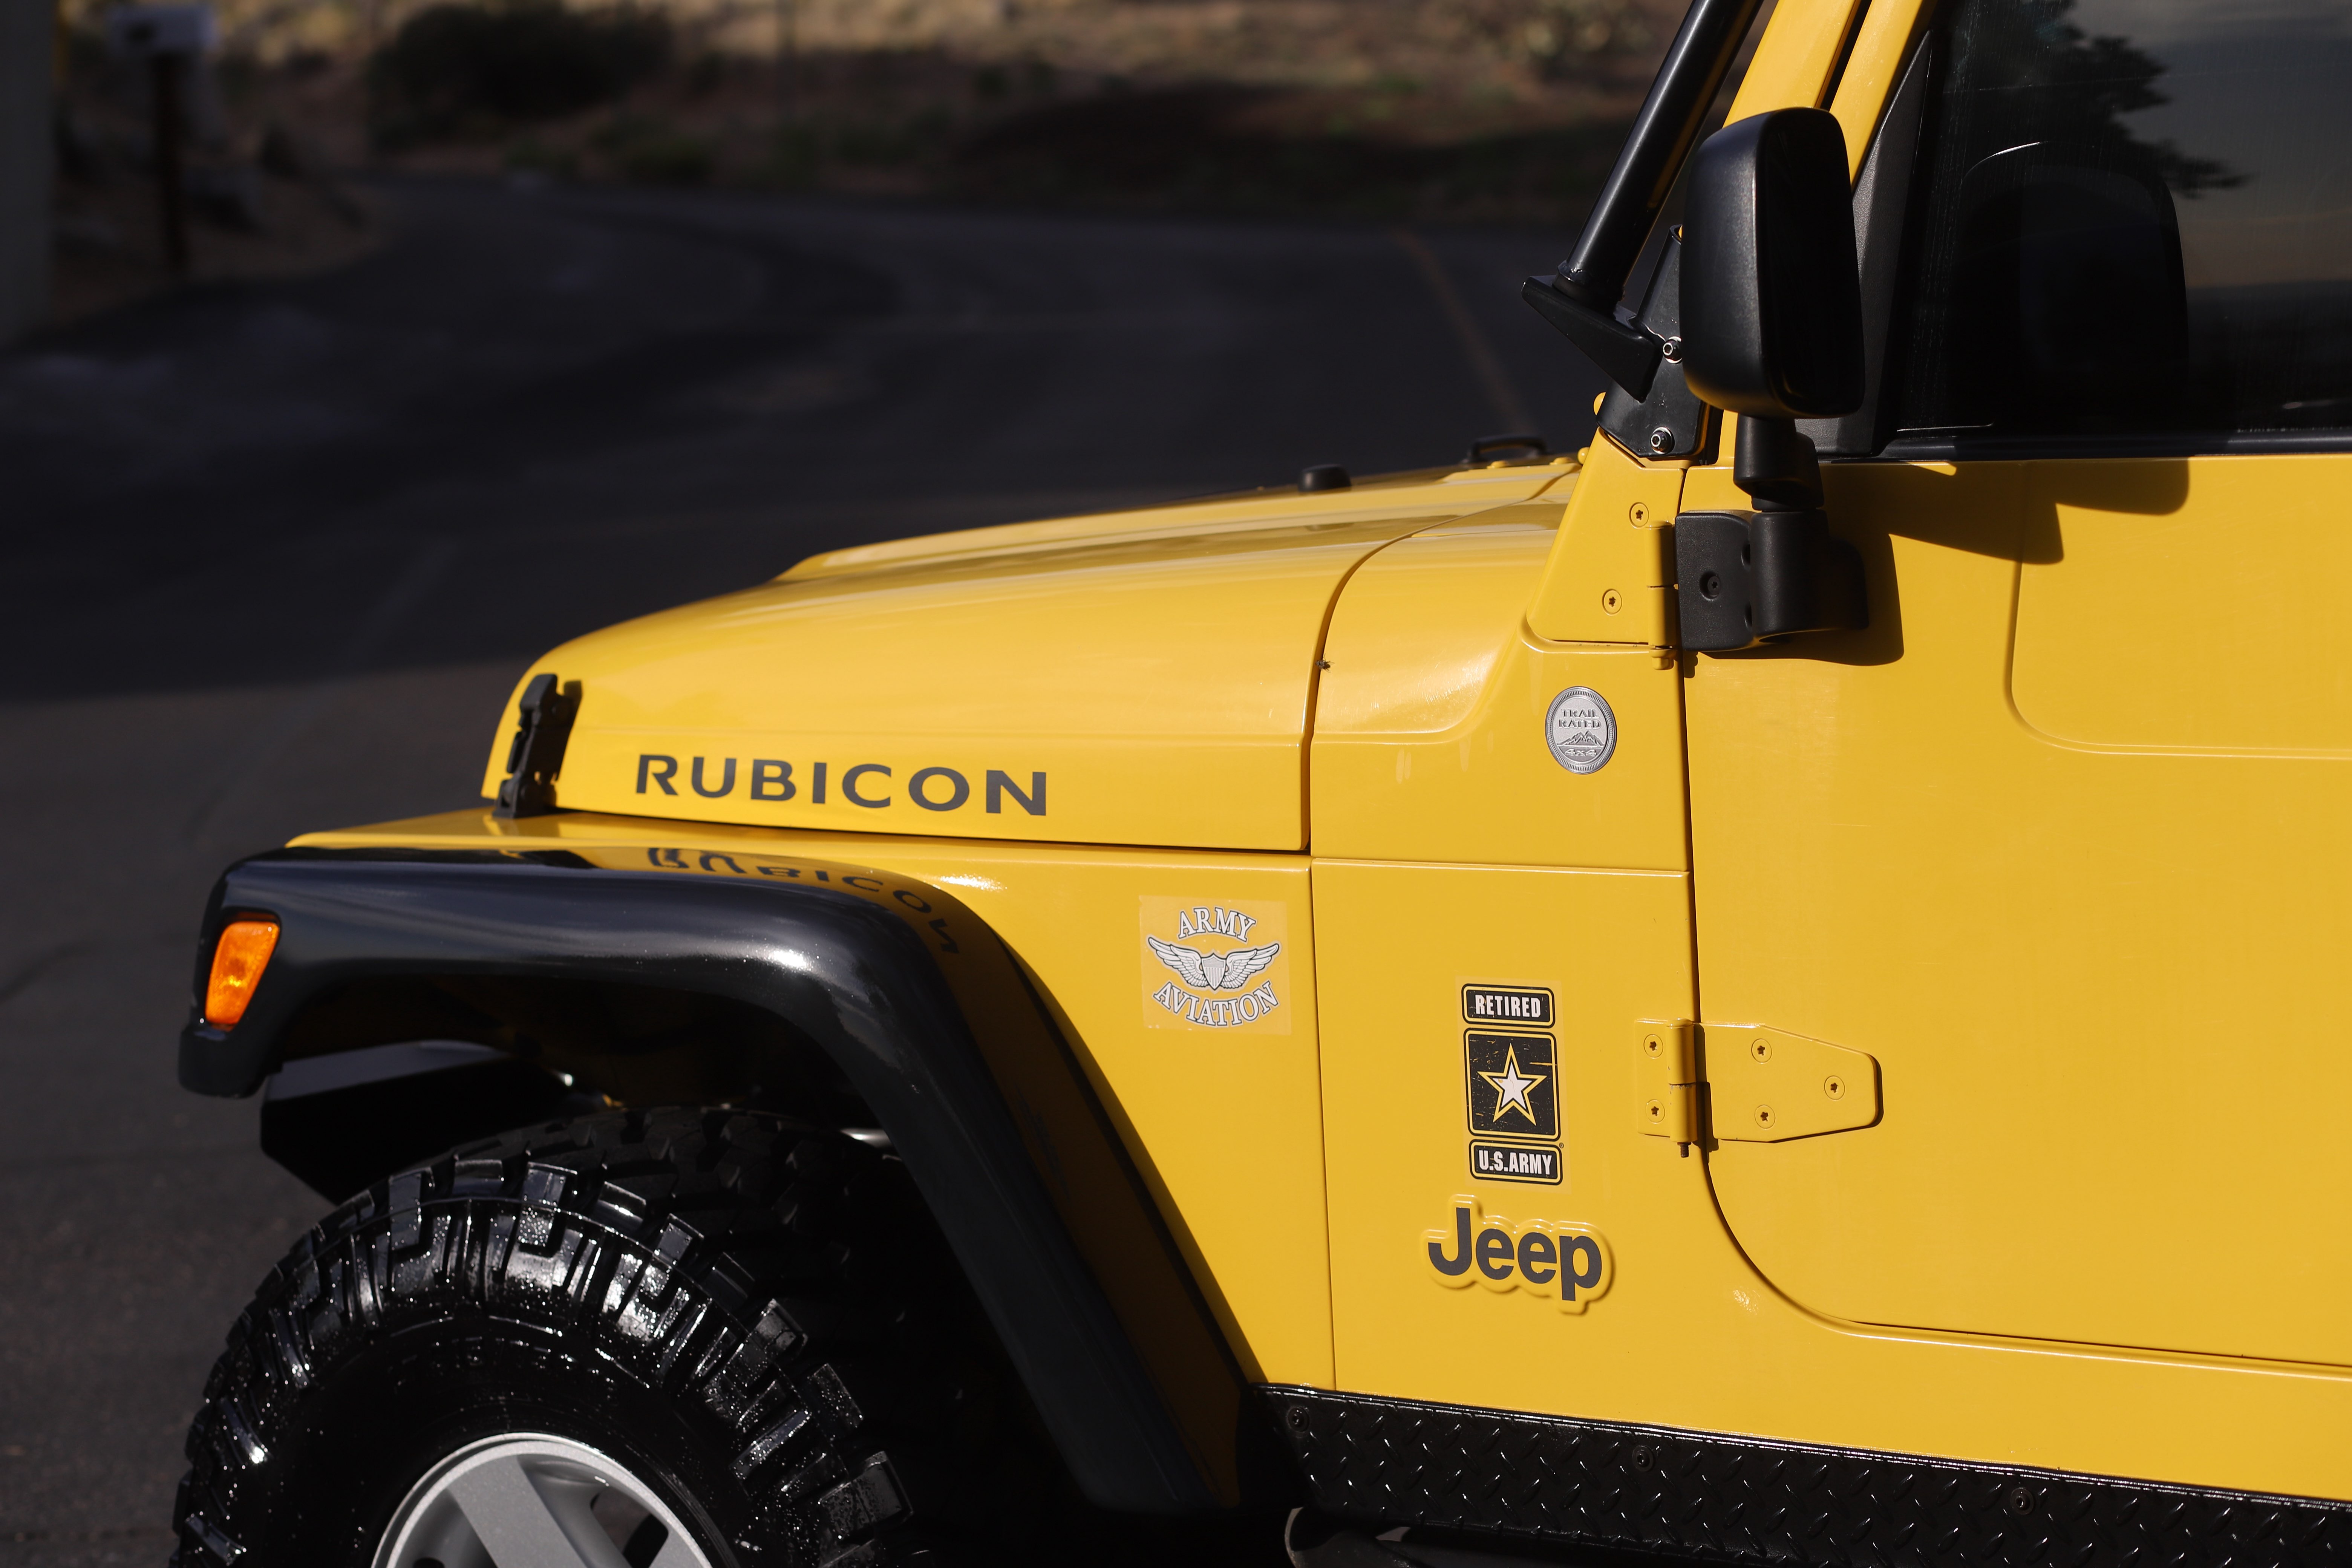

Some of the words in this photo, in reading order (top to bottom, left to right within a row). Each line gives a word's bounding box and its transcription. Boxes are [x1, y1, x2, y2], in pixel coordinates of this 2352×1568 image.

[1559, 719, 1602, 729] RATED
[1561, 708, 1600, 719] TRAIL
[1565, 748, 1597, 757] 4x4
[635, 753, 1047, 816] RUBICON
[1178, 906, 1257, 942] ARMY
[1153, 980, 1279, 1026] AVIATION
[1475, 994, 1542, 1018] RETIRED
[1428, 1207, 1602, 1302] Jeep
